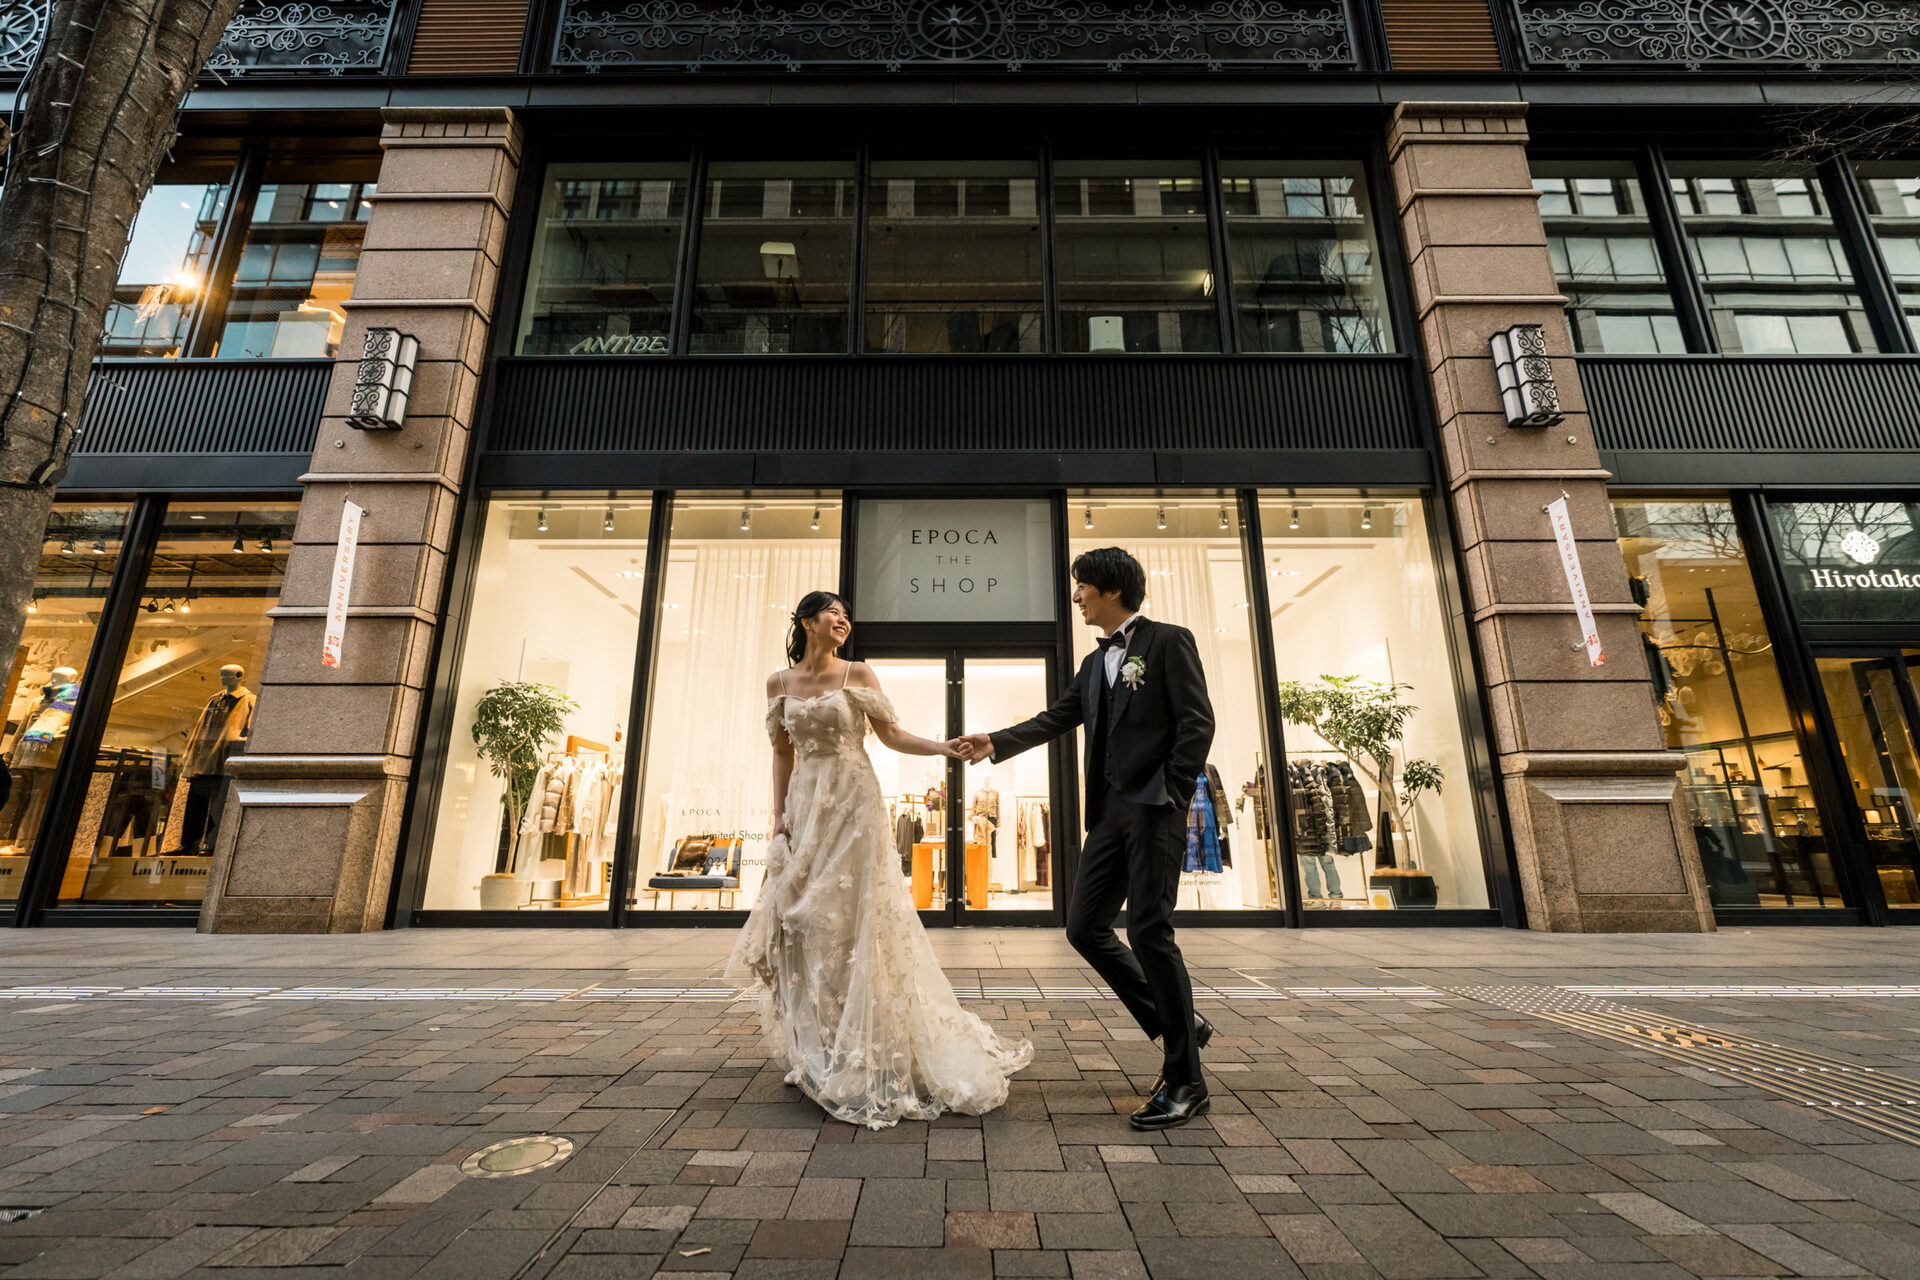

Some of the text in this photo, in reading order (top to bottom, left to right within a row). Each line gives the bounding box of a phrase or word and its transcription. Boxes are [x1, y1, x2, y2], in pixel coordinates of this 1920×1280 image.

[569, 334, 669, 354] ANTIBE
[912, 529, 997, 544] EPOCA
[936, 555, 971, 565] THE
[1556, 514, 1591, 619] ANNIVERSARY
[335, 517, 355, 622] ANNIVERSARY
[910, 578, 997, 593] SHOP
[681, 808, 720, 816] EPOCA
[738, 830, 764, 842] Shop
